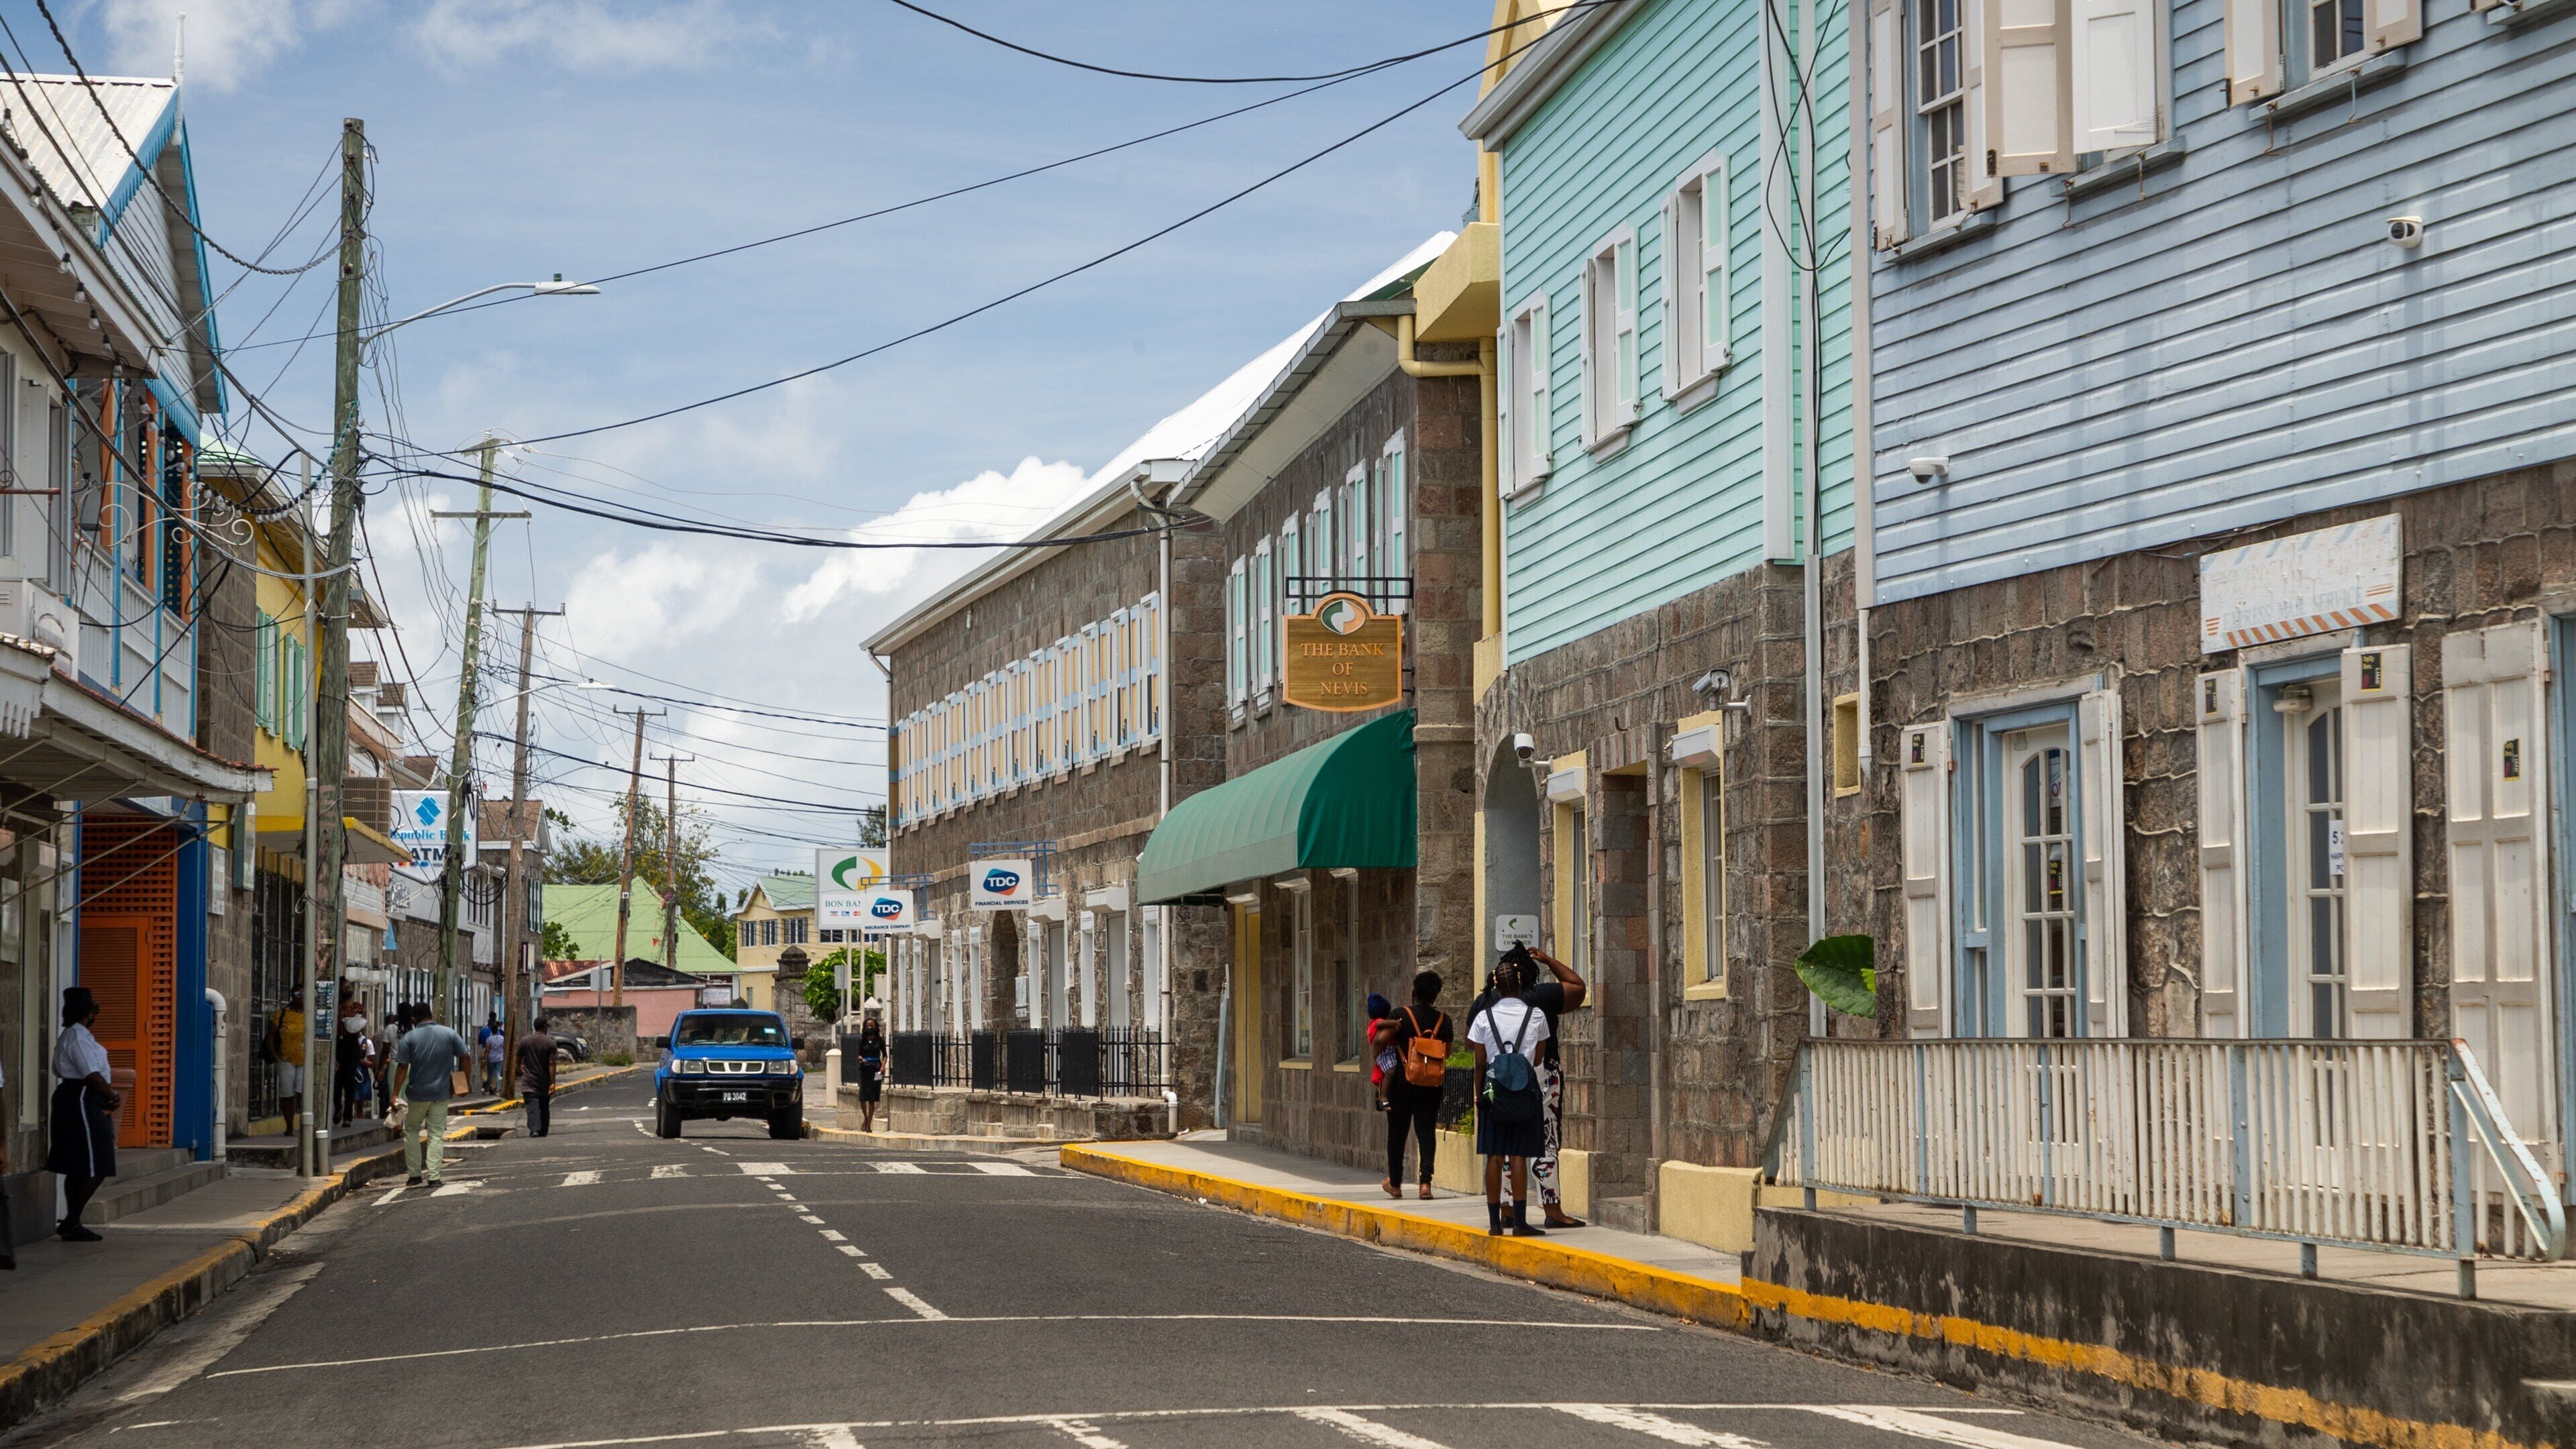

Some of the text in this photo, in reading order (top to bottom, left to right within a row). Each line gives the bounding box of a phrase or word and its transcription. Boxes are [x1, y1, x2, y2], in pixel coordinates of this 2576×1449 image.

[1301, 643, 1385, 657] THE BANK
[1332, 663, 1354, 676] OF
[1320, 682, 1368, 696] NEVIS
[439, 829, 470, 840] Bk
[411, 848, 445, 861] ATM
[987, 876, 1016, 887] TDC
[875, 904, 900, 913] TDC
